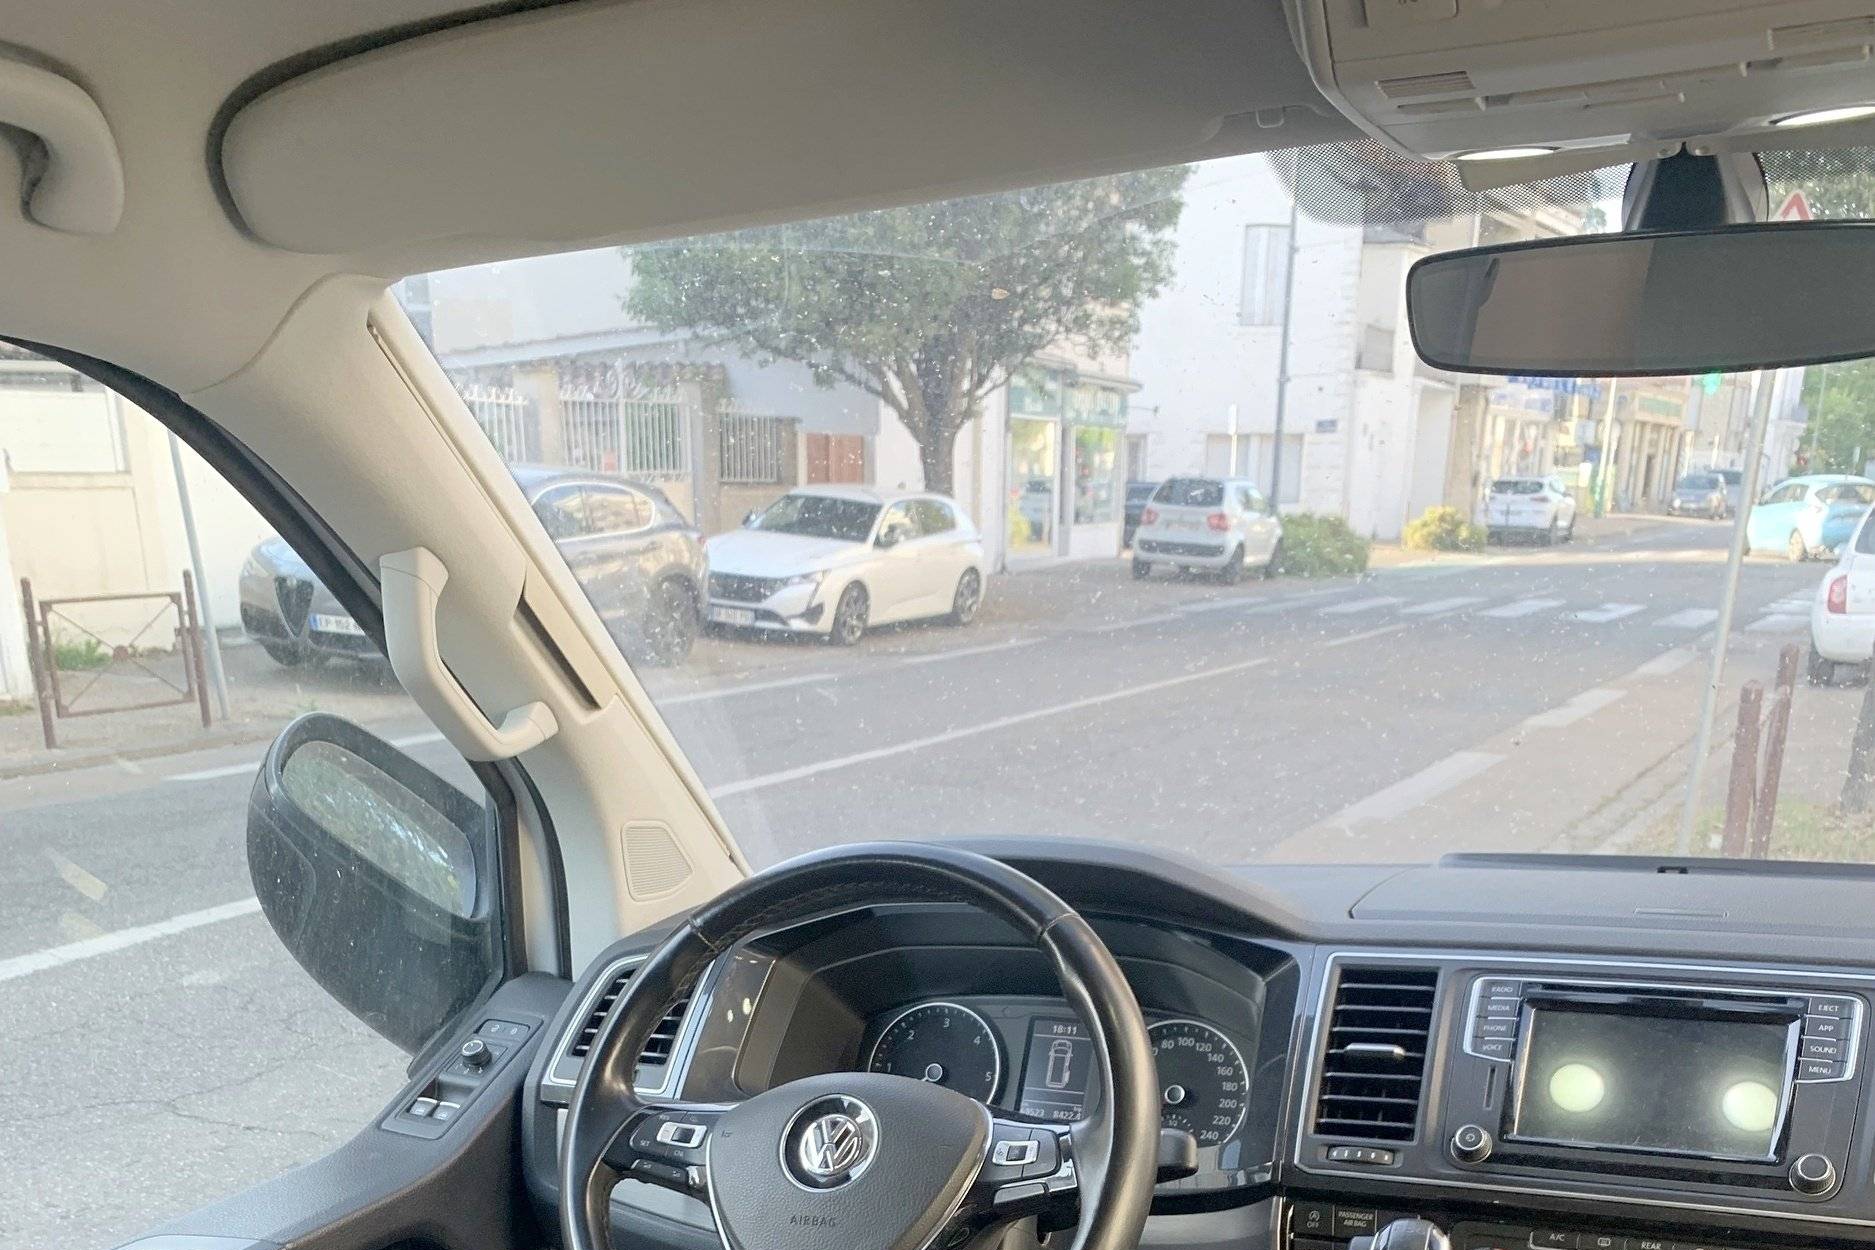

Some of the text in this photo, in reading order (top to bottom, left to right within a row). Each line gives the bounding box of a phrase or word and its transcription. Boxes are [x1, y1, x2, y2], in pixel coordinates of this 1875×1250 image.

[1818, 1004, 1839, 1012] EJECT
[943, 1018, 950, 1028] 3
[1818, 1024, 1834, 1032] APP
[907, 1030, 915, 1040] 2
[974, 1036, 981, 1046] 4
[1161, 1040, 1174, 1049] 80
[1178, 1037, 1195, 1046] 100
[1196, 1042, 1212, 1052] 120
[1810, 1045, 1837, 1053] SOUND
[1207, 1053, 1224, 1063] 140
[1217, 1067, 1233, 1076] 160
[1808, 1066, 1831, 1074] MENU
[985, 1071, 992, 1081] 5
[1222, 1082, 1238, 1091] 180
[1219, 1099, 1237, 1108] 200
[1212, 1115, 1231, 1125] 220
[1200, 1130, 1219, 1140] 240
[1338, 1211, 1374, 1220] PASSENGER
[789, 1215, 836, 1227] AIRBAG
[1550, 1234, 1565, 1242] A/C
[1641, 1241, 1662, 1250] REAR
